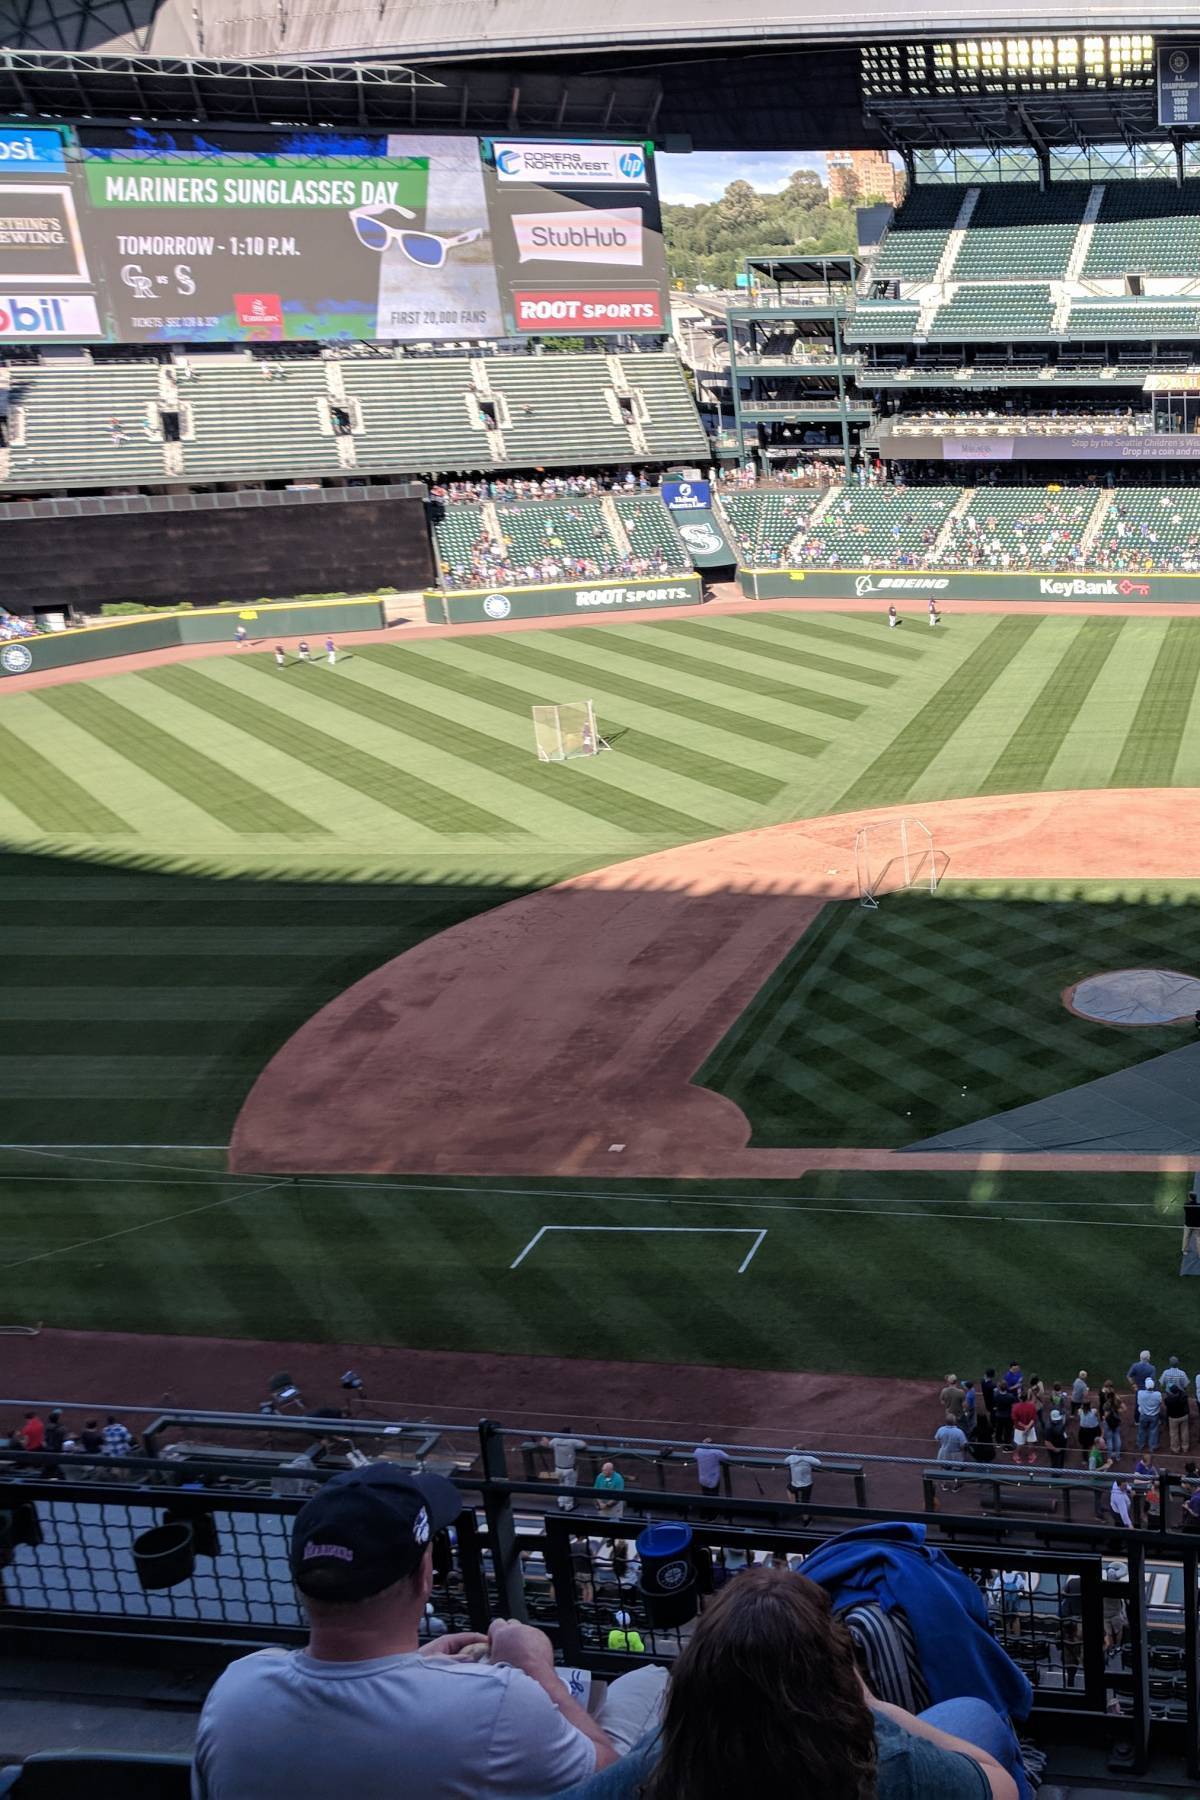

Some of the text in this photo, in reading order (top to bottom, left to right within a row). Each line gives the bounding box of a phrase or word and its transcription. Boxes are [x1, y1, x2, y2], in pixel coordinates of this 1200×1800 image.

[524, 152, 581, 162] COPIERS
[525, 161, 608, 171] NORTHWEST
[623, 154, 641, 178] hp
[106, 176, 398, 205] MARINERS SUNGLASSES DAY
[117, 235, 214, 256] TOMORROW
[230, 237, 264, 256] 1:10
[268, 237, 301, 256] P.M.
[531, 226, 627, 248] StubHub
[174, 264, 196, 296] S
[391, 309, 488, 325] FIRST 20,000 FANS
[520, 300, 579, 319] ROOT
[1072, 438, 1089, 448] Stop
[1090, 439, 1100, 448] by
[1101, 439, 1113, 447] the
[1115, 439, 1142, 447] Seattle
[1144, 438, 1184, 447] Children's
[1122, 447, 1141, 457] Drop
[1142, 448, 1151, 456] in
[1158, 448, 1175, 456] coin
[1176, 448, 1191, 456] and
[877, 578, 949, 589] BOEING
[1040, 579, 1119, 597] KeyBank
[576, 588, 627, 606] ROOT
